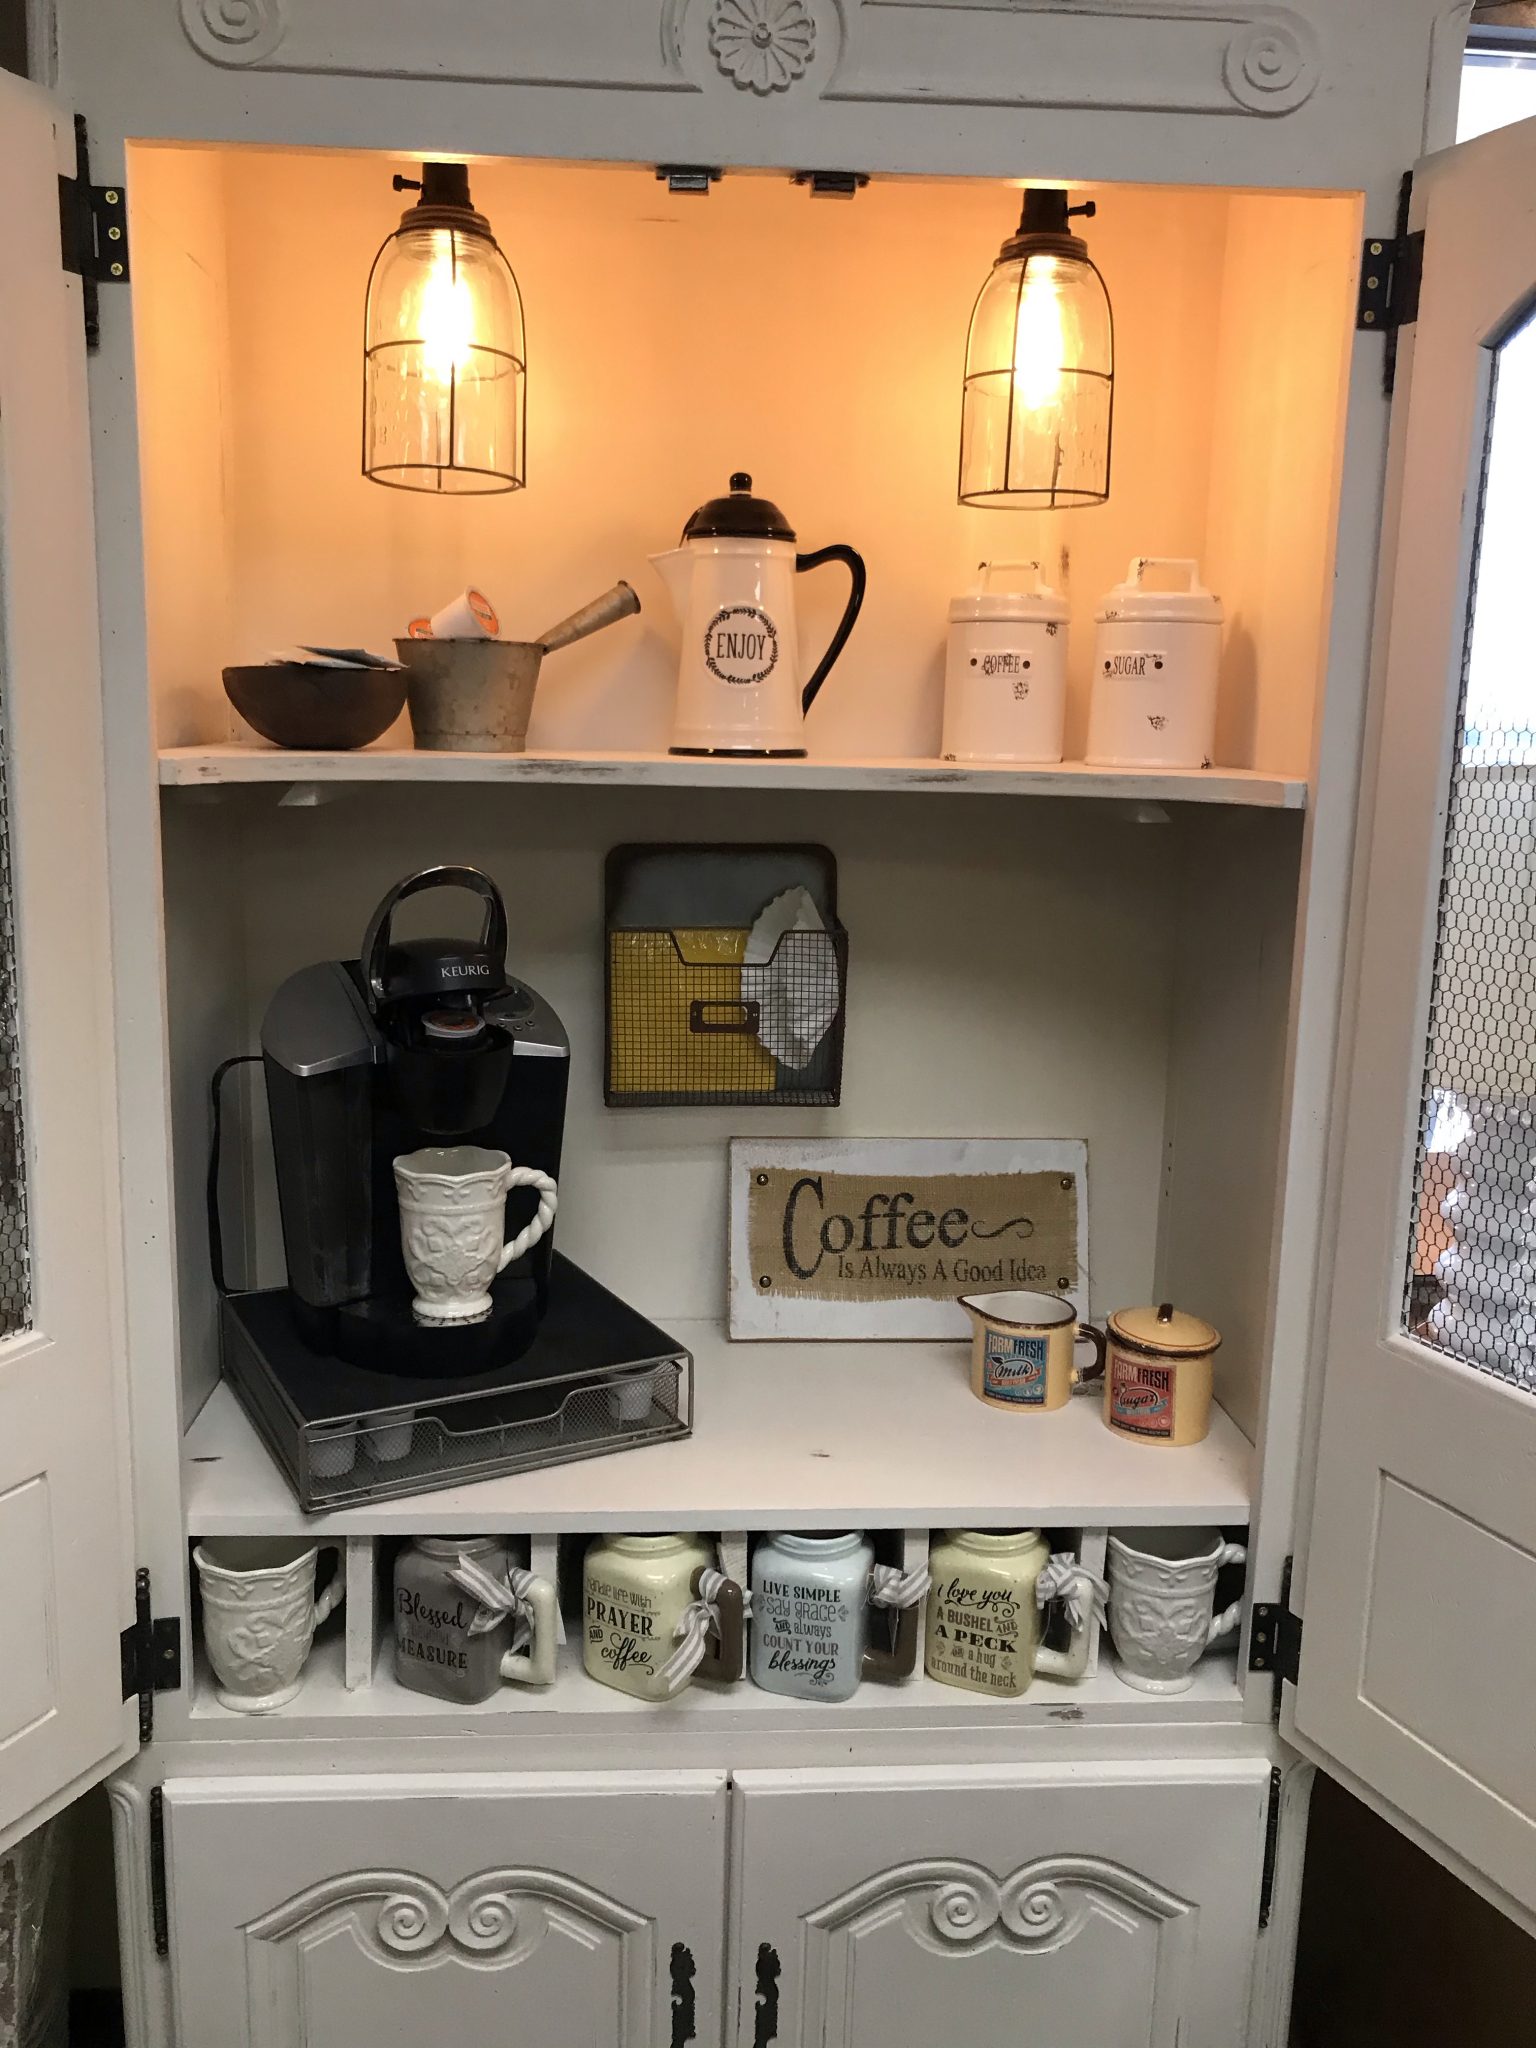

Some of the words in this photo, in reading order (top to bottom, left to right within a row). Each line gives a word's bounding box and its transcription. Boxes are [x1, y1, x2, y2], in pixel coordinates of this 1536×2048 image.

[716, 633, 766, 660] ENJOY
[983, 655, 1020, 674] COFFEE
[1113, 656, 1146, 676] SUGAR
[441, 964, 490, 978] KEURIG
[782, 1176, 969, 1280] Coffee
[838, 1255, 854, 1279] Is
[860, 1255, 927, 1286] Always
[933, 1259, 948, 1281] A
[954, 1259, 1003, 1282] Good
[1009, 1259, 1048, 1282] Idea
[988, 1333, 1014, 1354] FARM
[1013, 1339, 1045, 1361] FRESH
[1114, 1359, 1138, 1382] FARM
[1137, 1368, 1170, 1392] FRESH
[763, 1580, 790, 1598] LIVE
[793, 1586, 841, 1603] SIMPLE
[946, 1578, 977, 1601] love
[977, 1589, 1013, 1609] you
[397, 1587, 468, 1629] Blessed
[587, 1596, 654, 1637] PRAYER
[936, 1605, 944, 1621] A
[947, 1608, 994, 1633] BUSHEL
[996, 1620, 1018, 1635] AND
[763, 1633, 802, 1652] COUNT
[805, 1640, 839, 1656] YOUR
[794, 1619, 832, 1640] always
[935, 1624, 950, 1639] A
[954, 1628, 1018, 1654] PECK
[601, 1635, 653, 1671] coffee
[768, 1650, 836, 1680] blessings
[976, 1647, 997, 1669] hug
[930, 1656, 968, 1679] around
[970, 1665, 988, 1684] the
[990, 1672, 1017, 1688] neck
